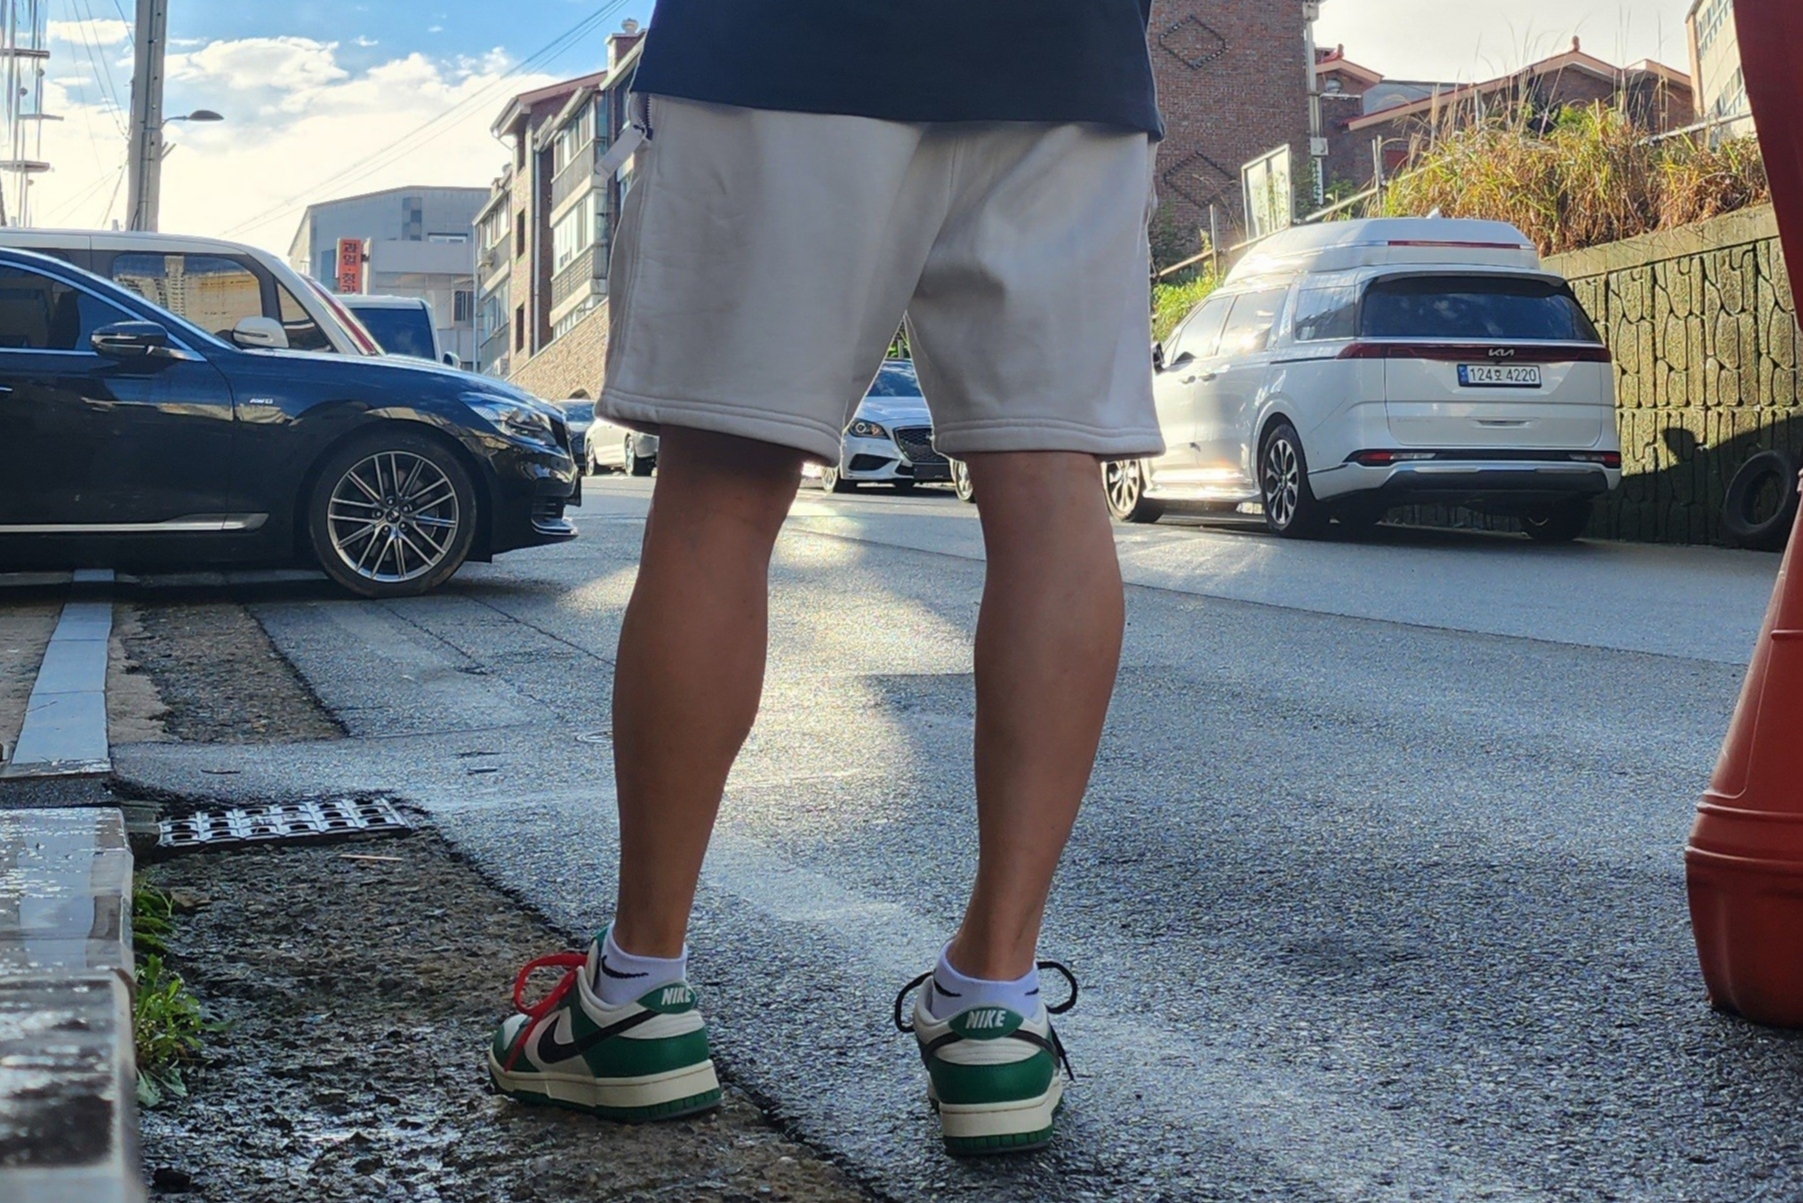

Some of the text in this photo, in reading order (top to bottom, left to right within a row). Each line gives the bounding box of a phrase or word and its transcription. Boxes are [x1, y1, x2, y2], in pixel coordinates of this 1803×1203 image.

[1506, 368, 1537, 382] 4220
[661, 987, 691, 1006] NIKE
[965, 1009, 1007, 1029] NIKE
